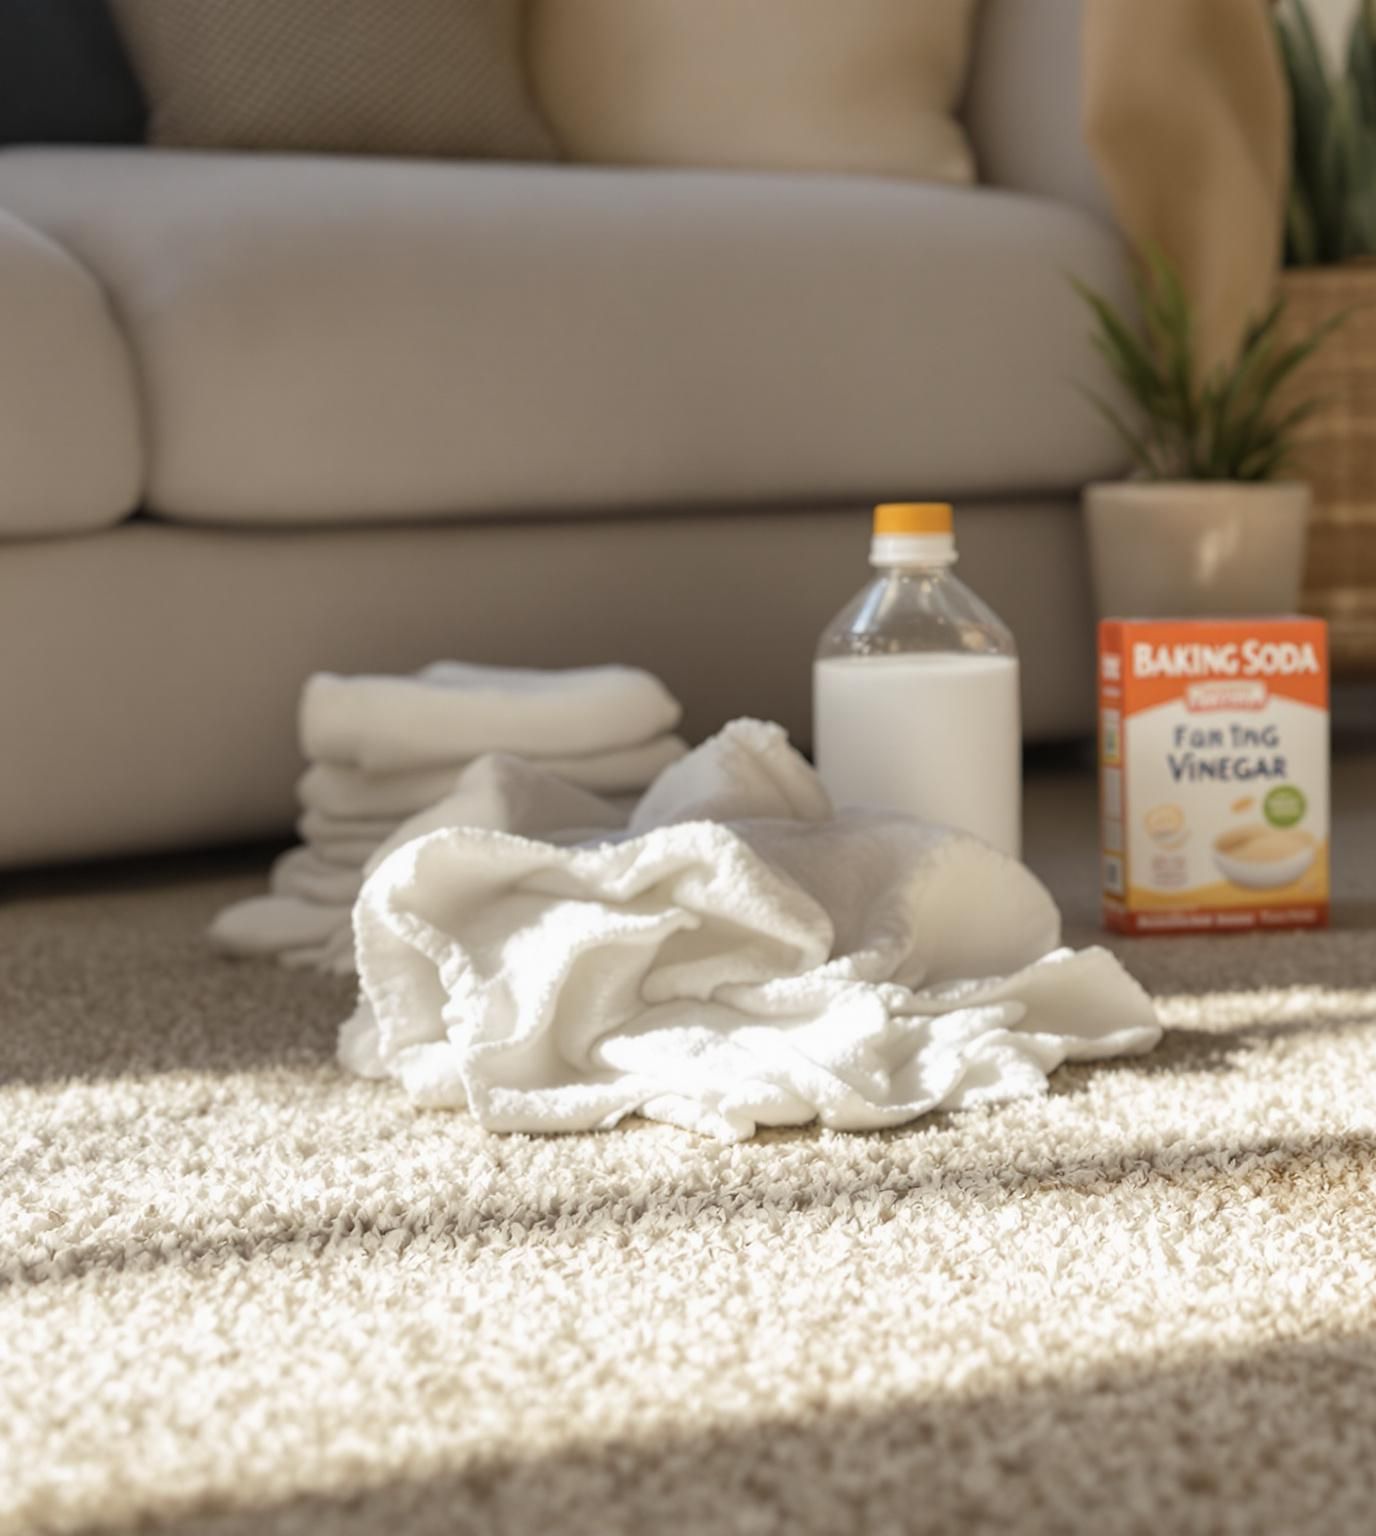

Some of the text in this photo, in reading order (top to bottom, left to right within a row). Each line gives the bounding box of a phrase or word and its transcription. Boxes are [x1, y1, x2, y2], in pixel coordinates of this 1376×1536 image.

[1133, 642, 1239, 678] BAKING
[1242, 639, 1319, 676] SODA
[1166, 752, 1287, 782] VINEGAR
